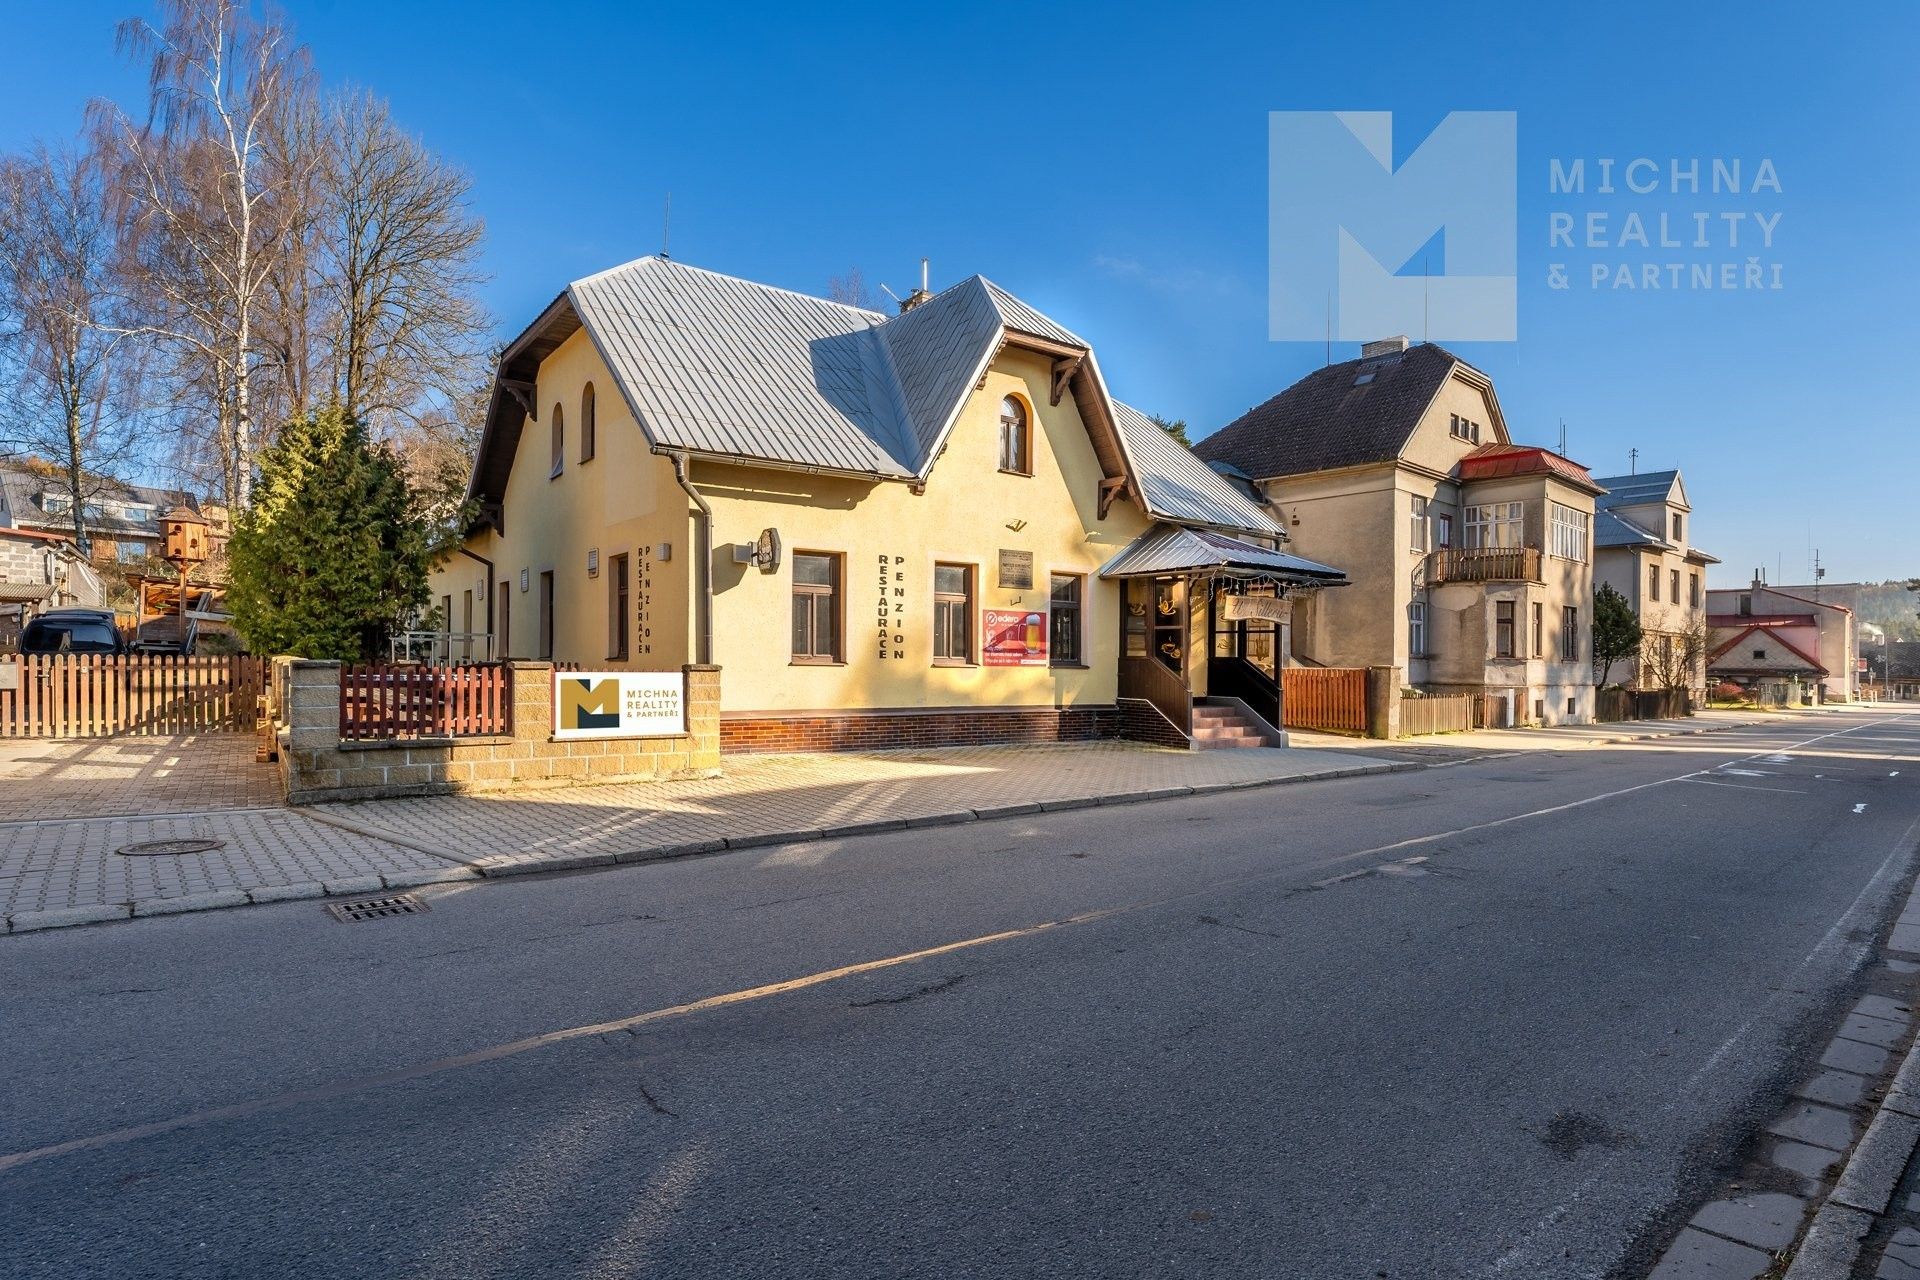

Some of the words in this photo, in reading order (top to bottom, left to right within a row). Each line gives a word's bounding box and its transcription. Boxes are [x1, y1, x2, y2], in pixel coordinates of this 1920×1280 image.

[878, 554, 889, 659] RESTAURACE
[893, 556, 905, 659] PENZION
[626, 689, 678, 698] MICHNA
[626, 700, 678, 710] REALITY
[636, 709, 679, 718] PARTNEŘI
